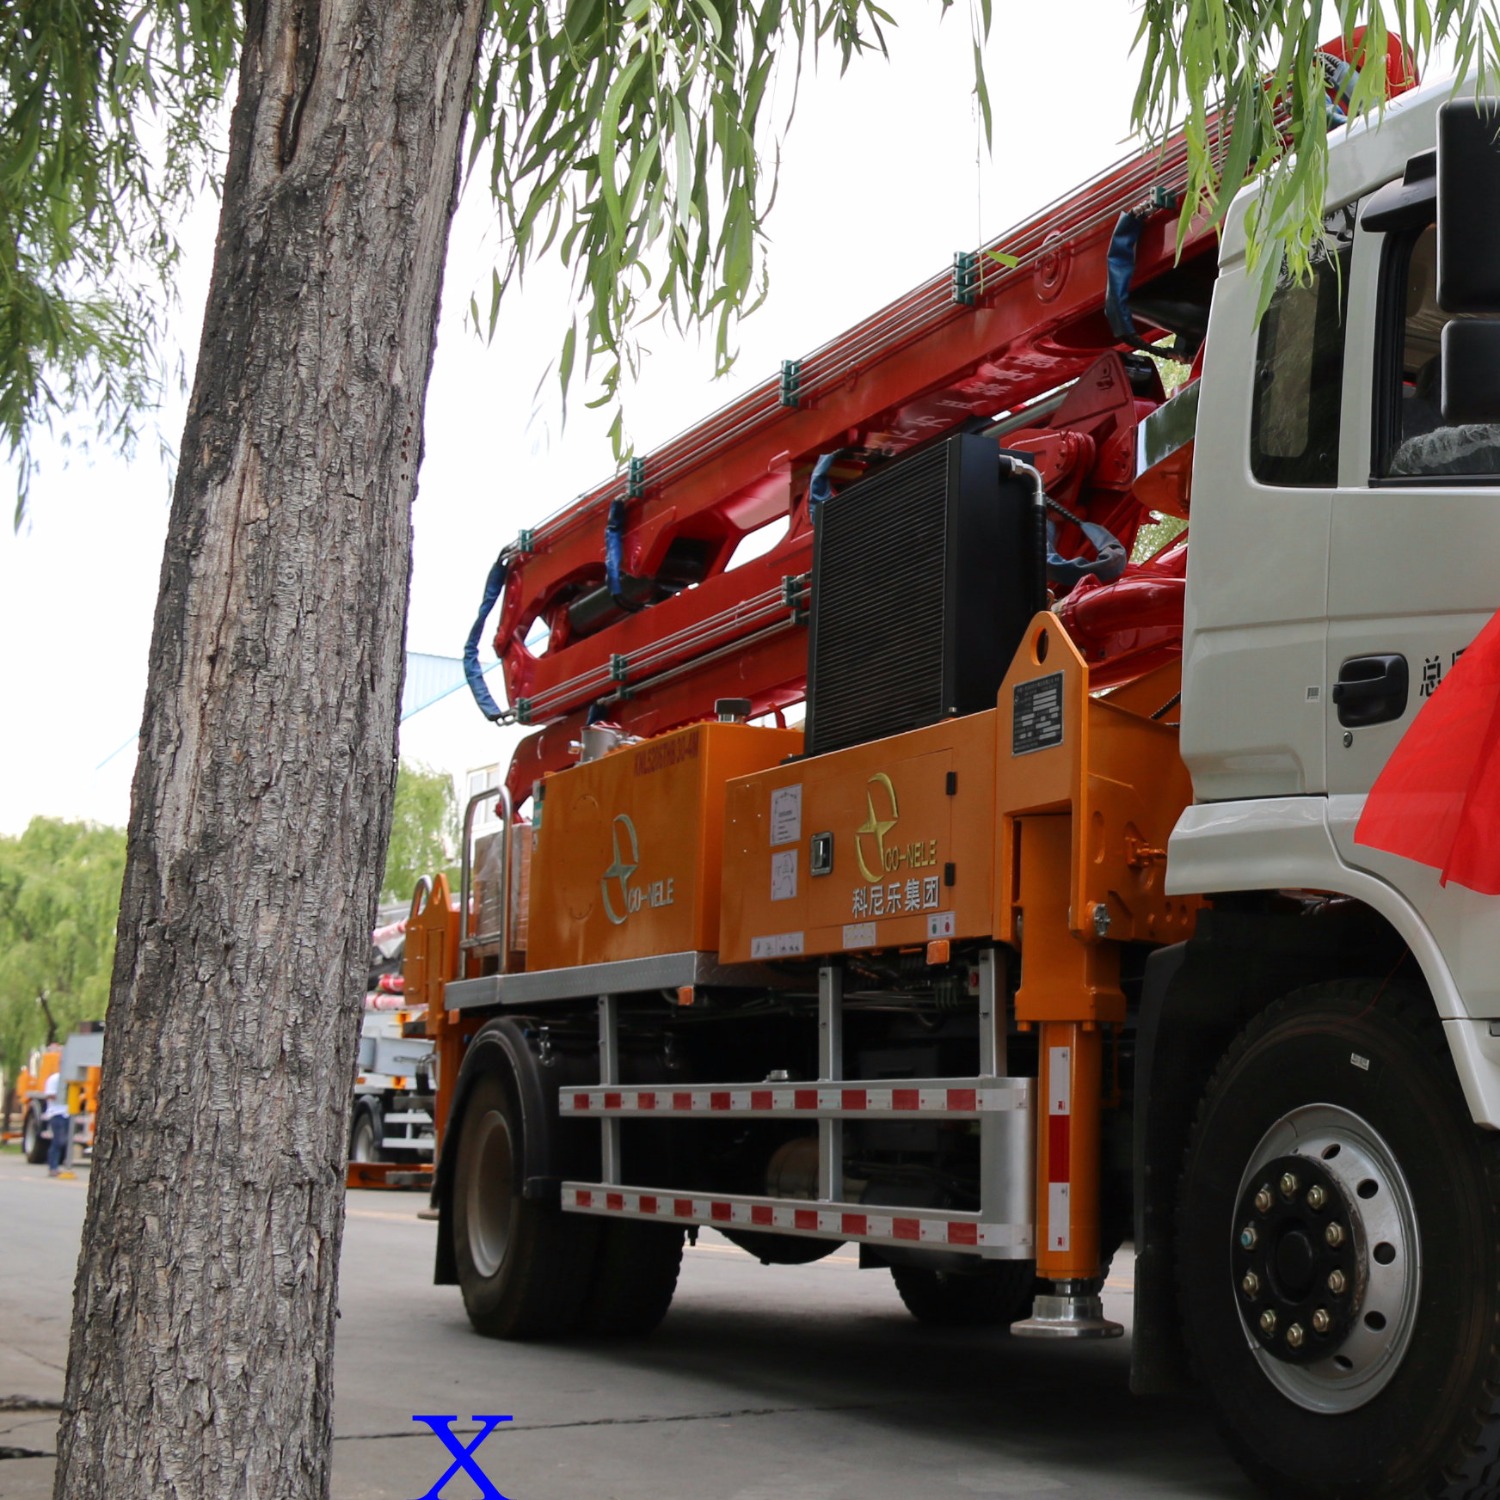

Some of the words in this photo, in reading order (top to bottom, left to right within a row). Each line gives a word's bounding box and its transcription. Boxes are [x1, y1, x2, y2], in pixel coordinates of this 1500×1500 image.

[884, 839, 938, 873] CO-NELE
[852, 875, 940, 919] 科尼乐集团
